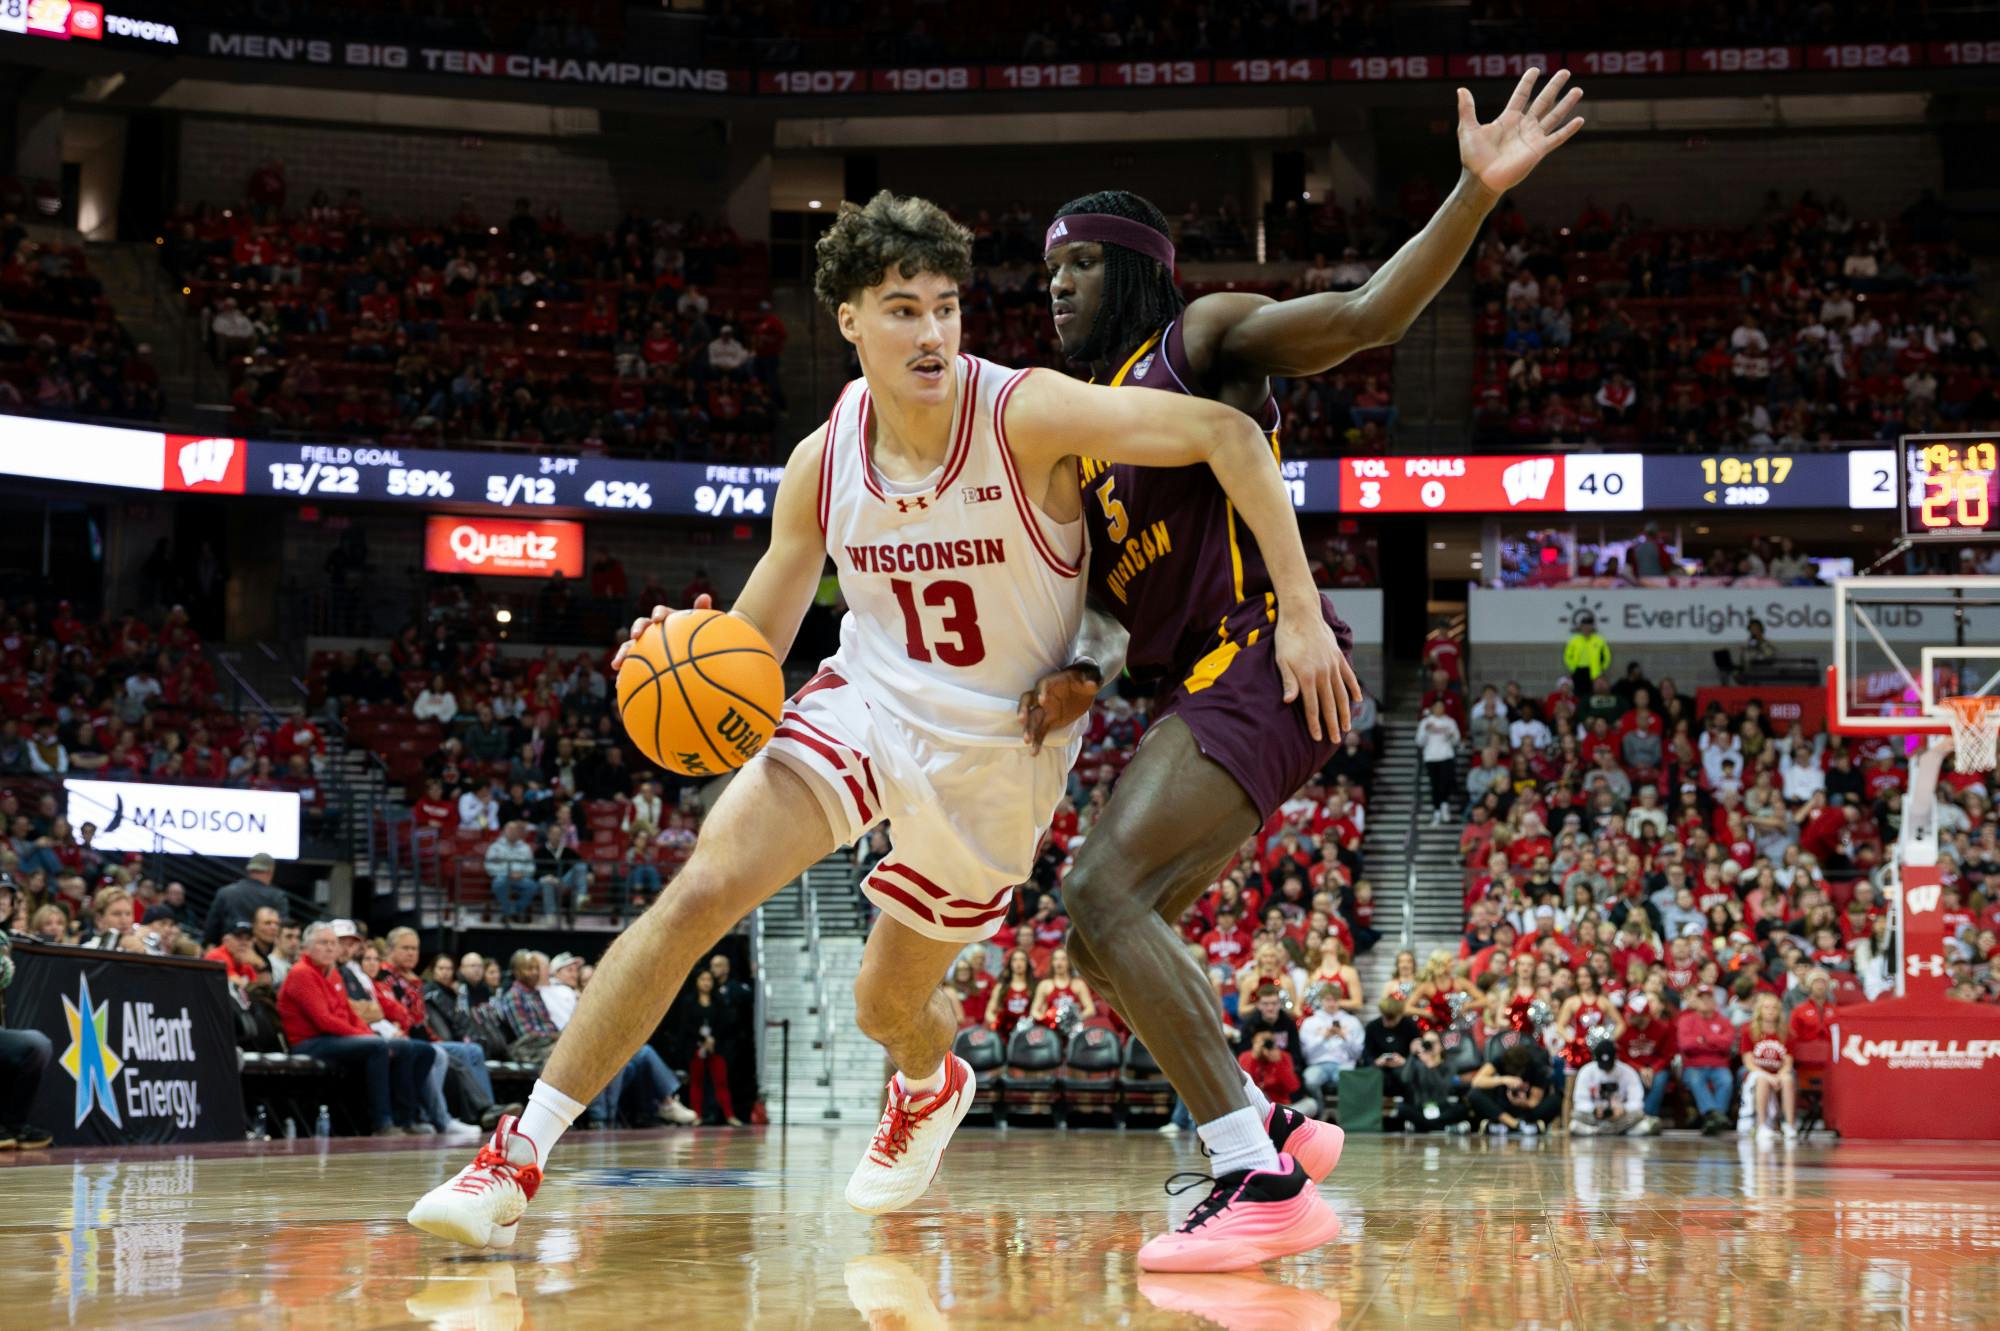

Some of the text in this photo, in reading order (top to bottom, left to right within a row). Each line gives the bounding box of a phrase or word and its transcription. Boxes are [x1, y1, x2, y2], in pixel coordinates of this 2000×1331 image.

[104, 14, 179, 45] TOYOTA
[208, 32, 729, 92] MEN'S BIG TEN CHAMPIONS
[1584, 50, 1666, 75] 1921
[1701, 47, 1790, 72] 1923
[1823, 43, 1912, 69] 1924
[1944, 40, 2000, 65] 192
[885, 67, 969, 91] 1908
[1003, 64, 1082, 88] 1912
[1118, 61, 1196, 86] 1913
[1232, 58, 1313, 82] 1914
[1349, 56, 1429, 80] 1916
[773, 70, 856, 93] 1907
[301, 445, 405, 467] FIELD GOAL
[539, 456, 579, 475] 3-PT
[1352, 458, 1466, 478] TOL FOULS
[1922, 442, 1996, 473] 19:17
[706, 465, 785, 484] FREE THR
[1578, 472, 1624, 495] 40
[1701, 457, 1793, 485] 19:17
[269, 462, 766, 516] 13/22 59% 5/12 42% 9/14
[1359, 480, 1446, 508] 3 0
[1723, 486, 1770, 505] 2ND
[1921, 475, 1989, 527] 20
[1096, 475, 1130, 544] 5
[450, 525, 559, 564] Quartz
[844, 538, 1007, 574] WISCONSIN
[890, 577, 987, 668] 13
[1623, 603, 1756, 635] Everlight
[1765, 602, 1834, 628] Sola
[717, 706, 762, 757] Wil
[133, 806, 266, 833] MADISON
[122, 1001, 196, 1062] Alliant
[1862, 1039, 2000, 1059] MUELLER
